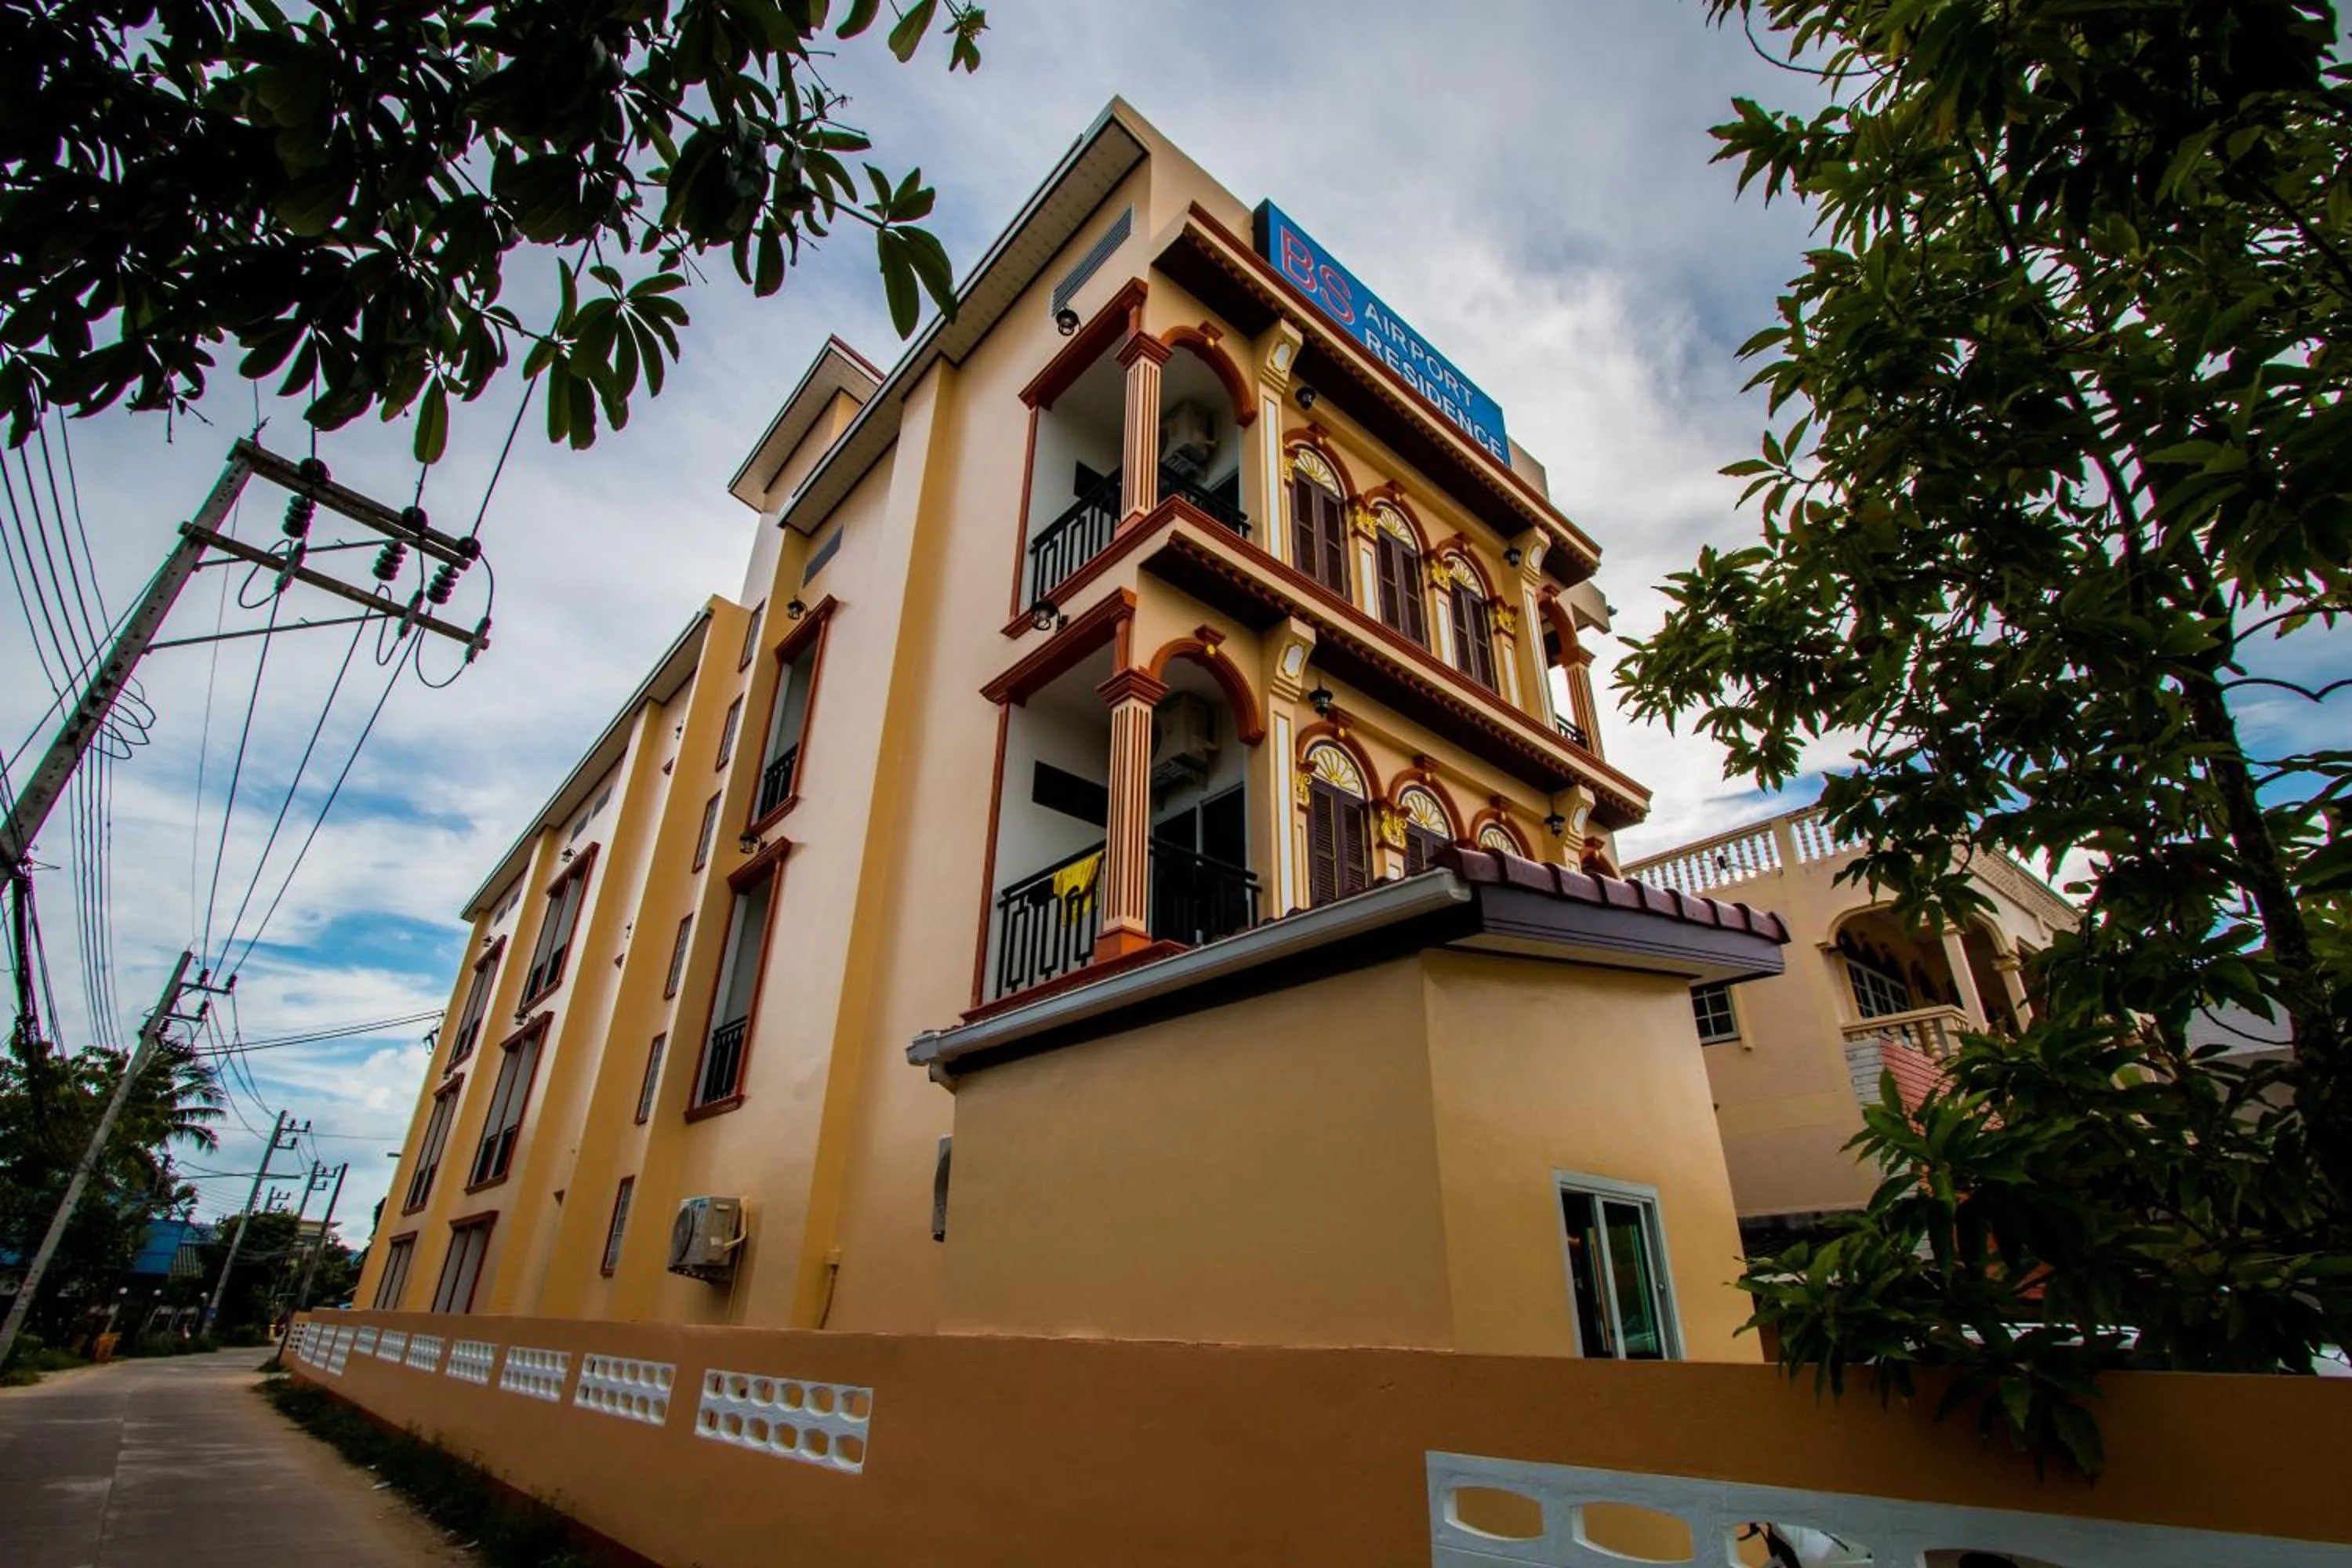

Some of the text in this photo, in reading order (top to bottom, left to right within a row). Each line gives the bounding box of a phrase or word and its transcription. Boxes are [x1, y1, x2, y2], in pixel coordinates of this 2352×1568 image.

[1279, 225, 1355, 325] BS
[1365, 303, 1472, 406] AIRPORT
[1365, 329, 1504, 456] RESIDENCE
